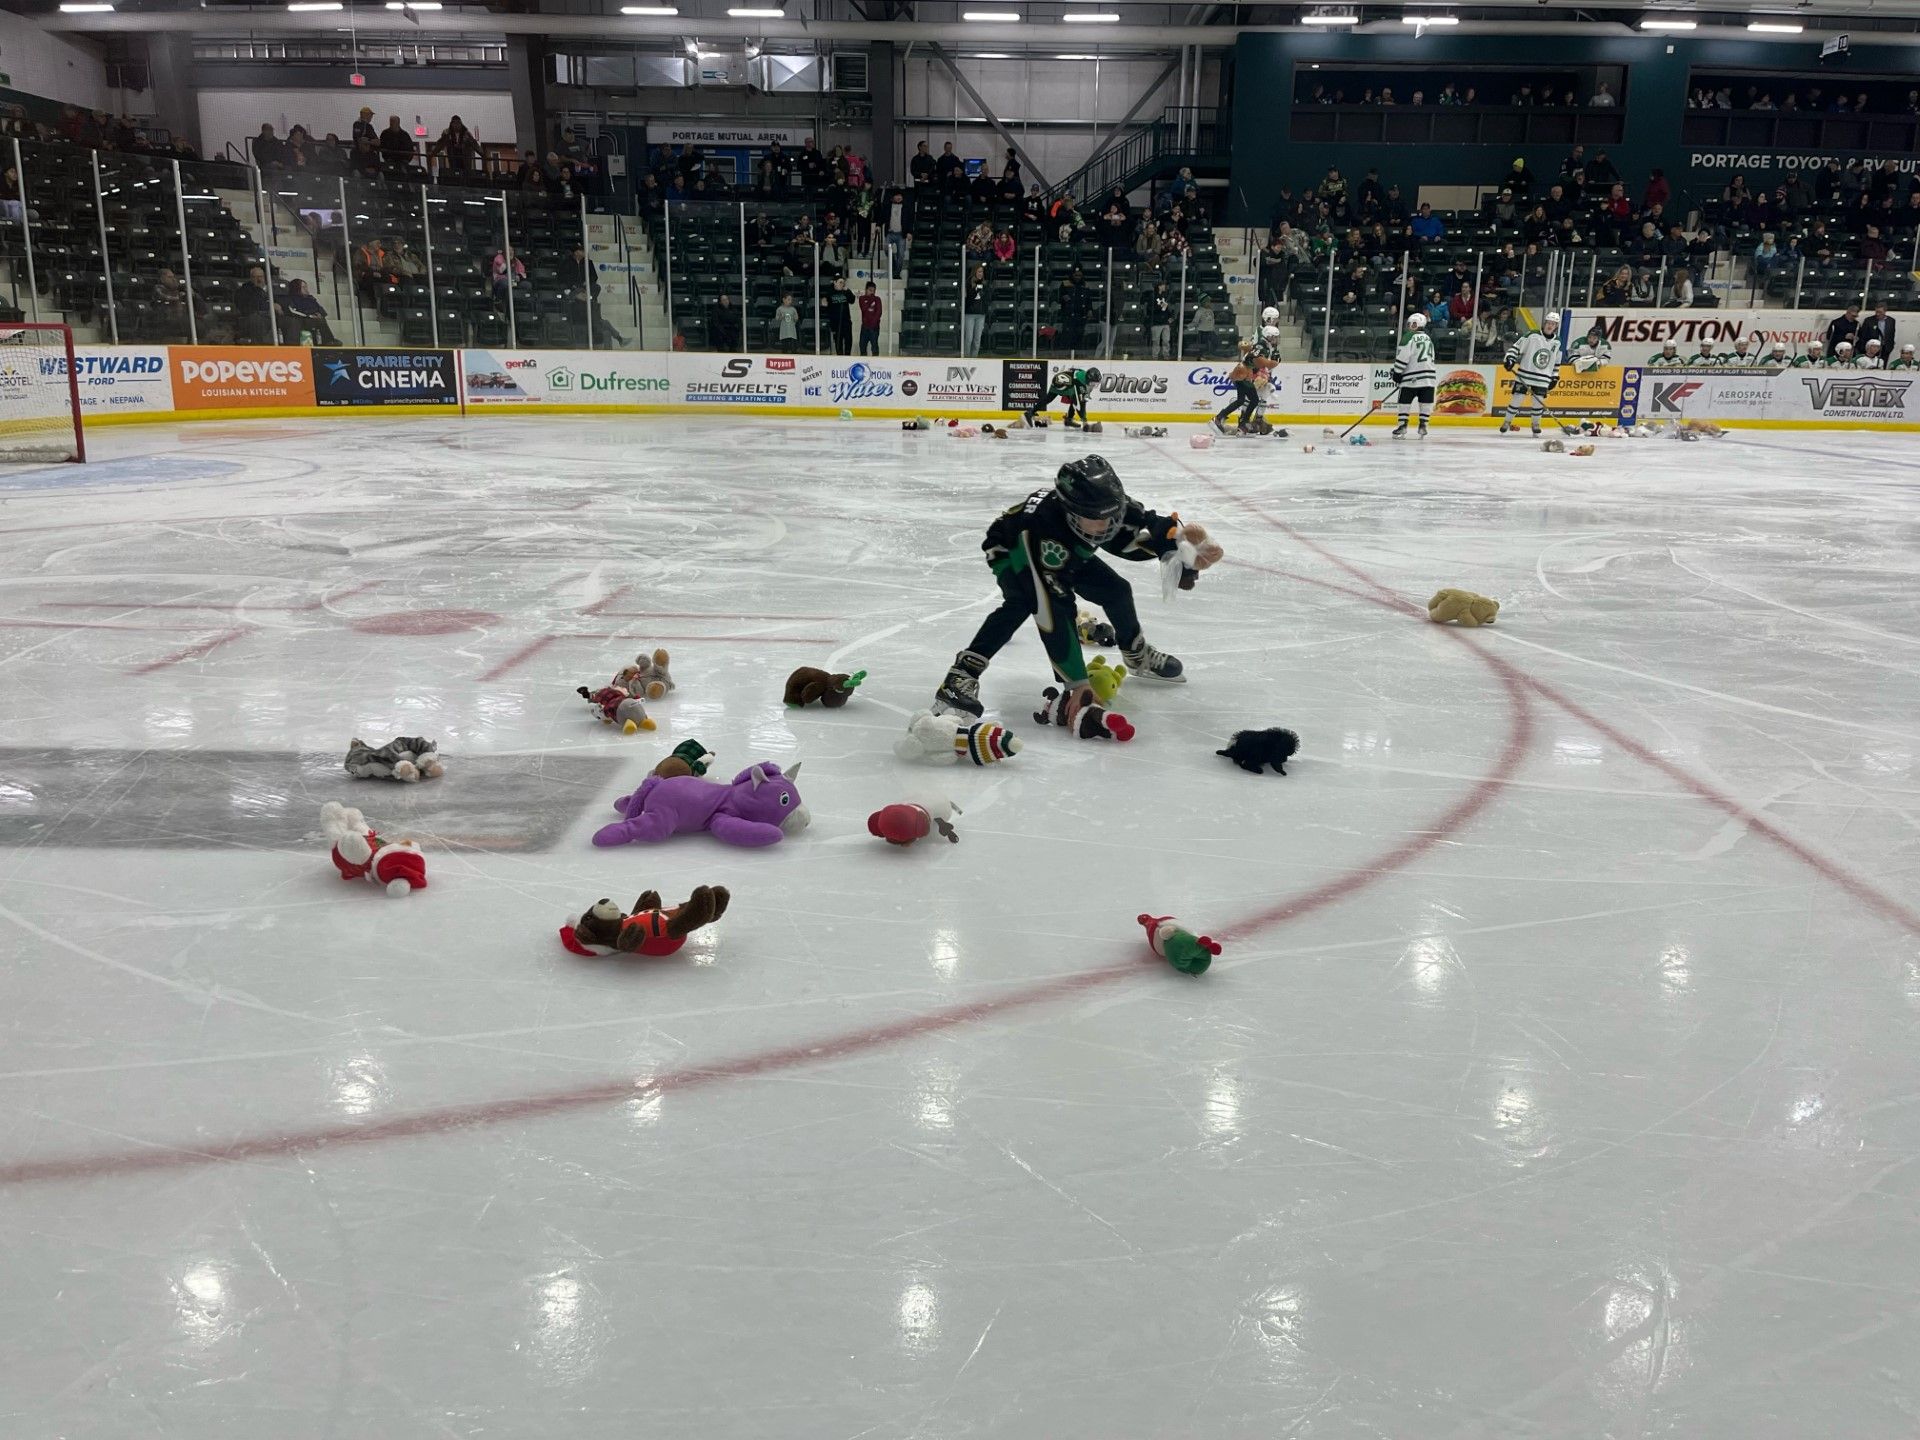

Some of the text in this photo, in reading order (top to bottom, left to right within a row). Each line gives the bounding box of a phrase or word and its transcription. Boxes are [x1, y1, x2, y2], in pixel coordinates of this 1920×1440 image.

[672, 132, 788, 142] PORTAGE MUTUAL ARENA
[1691, 154, 1771, 168] PORTAGE
[1594, 316, 1742, 343] MESEYTON
[38, 357, 163, 375] WESTWARD
[356, 355, 444, 368] PRAIRIE CITY
[505, 359, 537, 370] genAG
[769, 360, 792, 369] bryant
[802, 366, 814, 374] GOT
[831, 370, 848, 379] BLUE
[871, 371, 892, 380] MOON
[88, 377, 115, 385] FORD
[358, 370, 446, 389] CINEMA
[580, 371, 670, 391] Dufresne
[1099, 373, 1168, 394] Dino's
[201, 388, 287, 397] LOUISIANA KITCHEN
[686, 383, 788, 394] SHEWFELT'S
[804, 386, 822, 396] ICE
[829, 379, 894, 402] Water
[928, 383, 997, 393] POINT WEST
[1718, 391, 1773, 399] AEROSPACE
[1802, 377, 1914, 410] VERTEX
[110, 396, 144, 404] NEEPAWA
[1823, 410, 1905, 419] CONSTRUCTION LTD.
